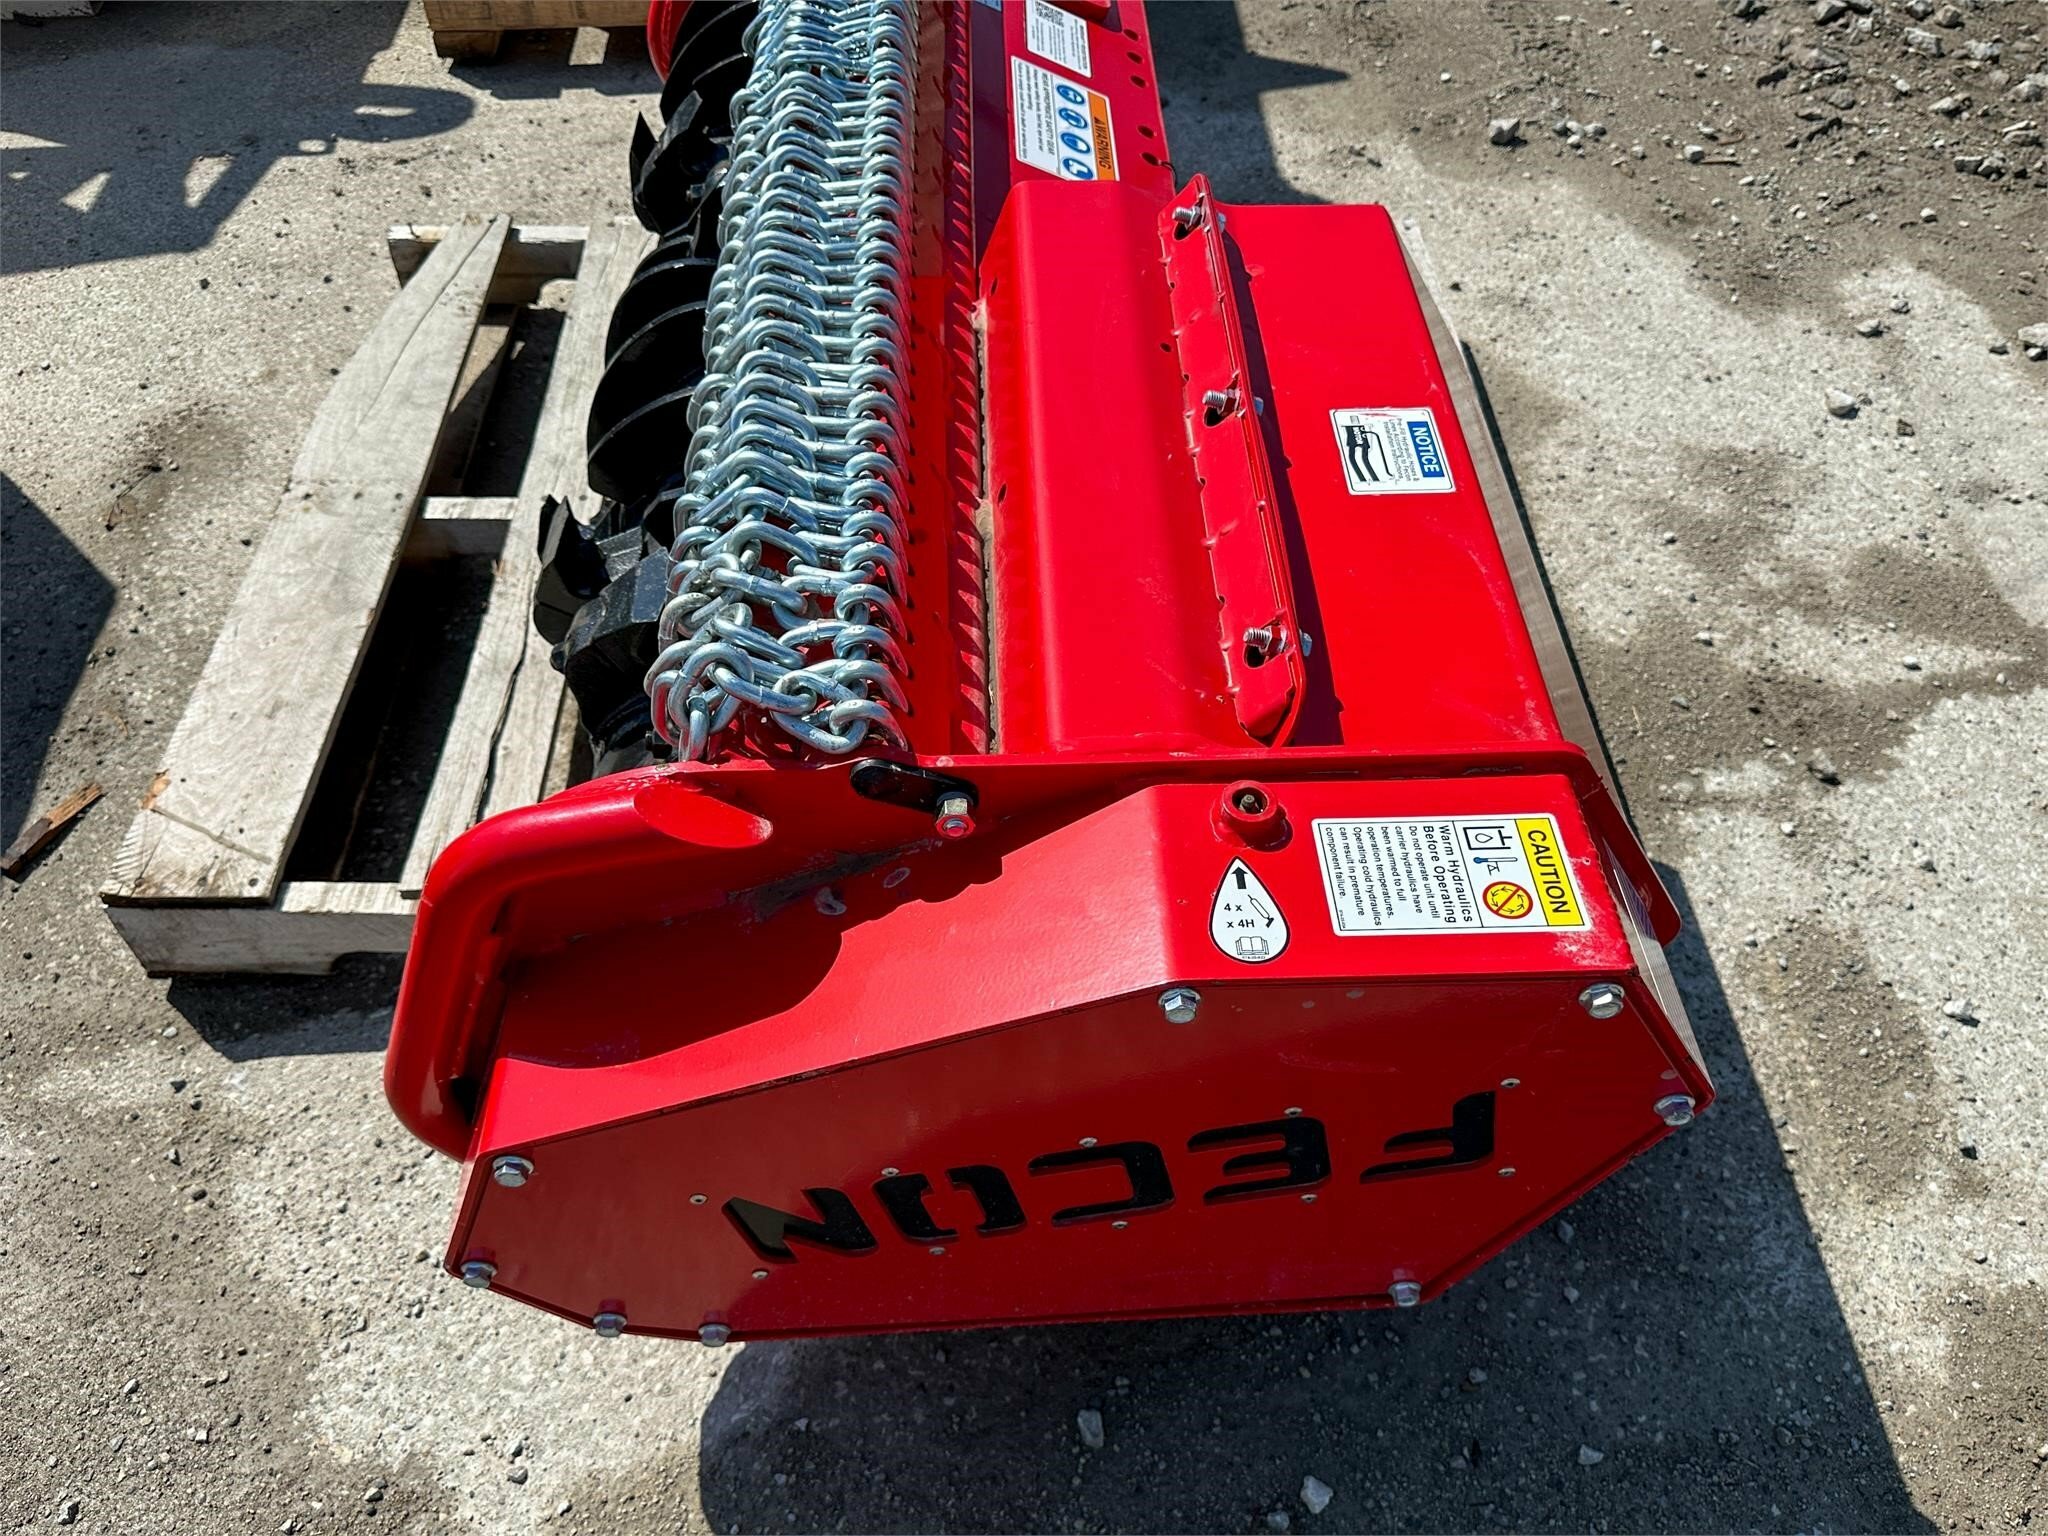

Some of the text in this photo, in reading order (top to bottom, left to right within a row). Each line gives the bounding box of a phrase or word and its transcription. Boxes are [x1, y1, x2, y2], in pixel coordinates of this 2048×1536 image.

[1043, 86, 1051, 119] APPROPRIATE
[1045, 119, 1053, 140] SAFETY
[1093, 124, 1111, 170] WARNING
[1352, 427, 1363, 444] MOTOR
[1383, 421, 1395, 447] Installation
[1388, 419, 1397, 431] Lines
[1392, 433, 1405, 457] According
[1399, 436, 1412, 458] Hydraulic
[1407, 460, 1417, 476] Hoses
[1402, 465, 1412, 480] Fecon
[1412, 427, 1440, 472] NOTICE
[1323, 827, 1341, 869] component
[1334, 871, 1348, 898] failure.
[1339, 827, 1365, 915] can result in premature
[1350, 826, 1383, 925] Operating cold hydraulics
[1364, 826, 1395, 918] operation temperatures.
[1380, 826, 1406, 900] been warmed to full
[1394, 825, 1424, 913] carrier hydraulics have
[1408, 825, 1440, 918] Do not operate unit until
[1422, 825, 1458, 923] Before Operating
[1437, 825, 1475, 922] Warm Hydraulics
[1526, 829, 1571, 913] CAUTION
[1224, 903, 1231, 911] 4
[1238, 919, 1254, 928] 4H
[722, 1091, 1496, 1262] FECON
